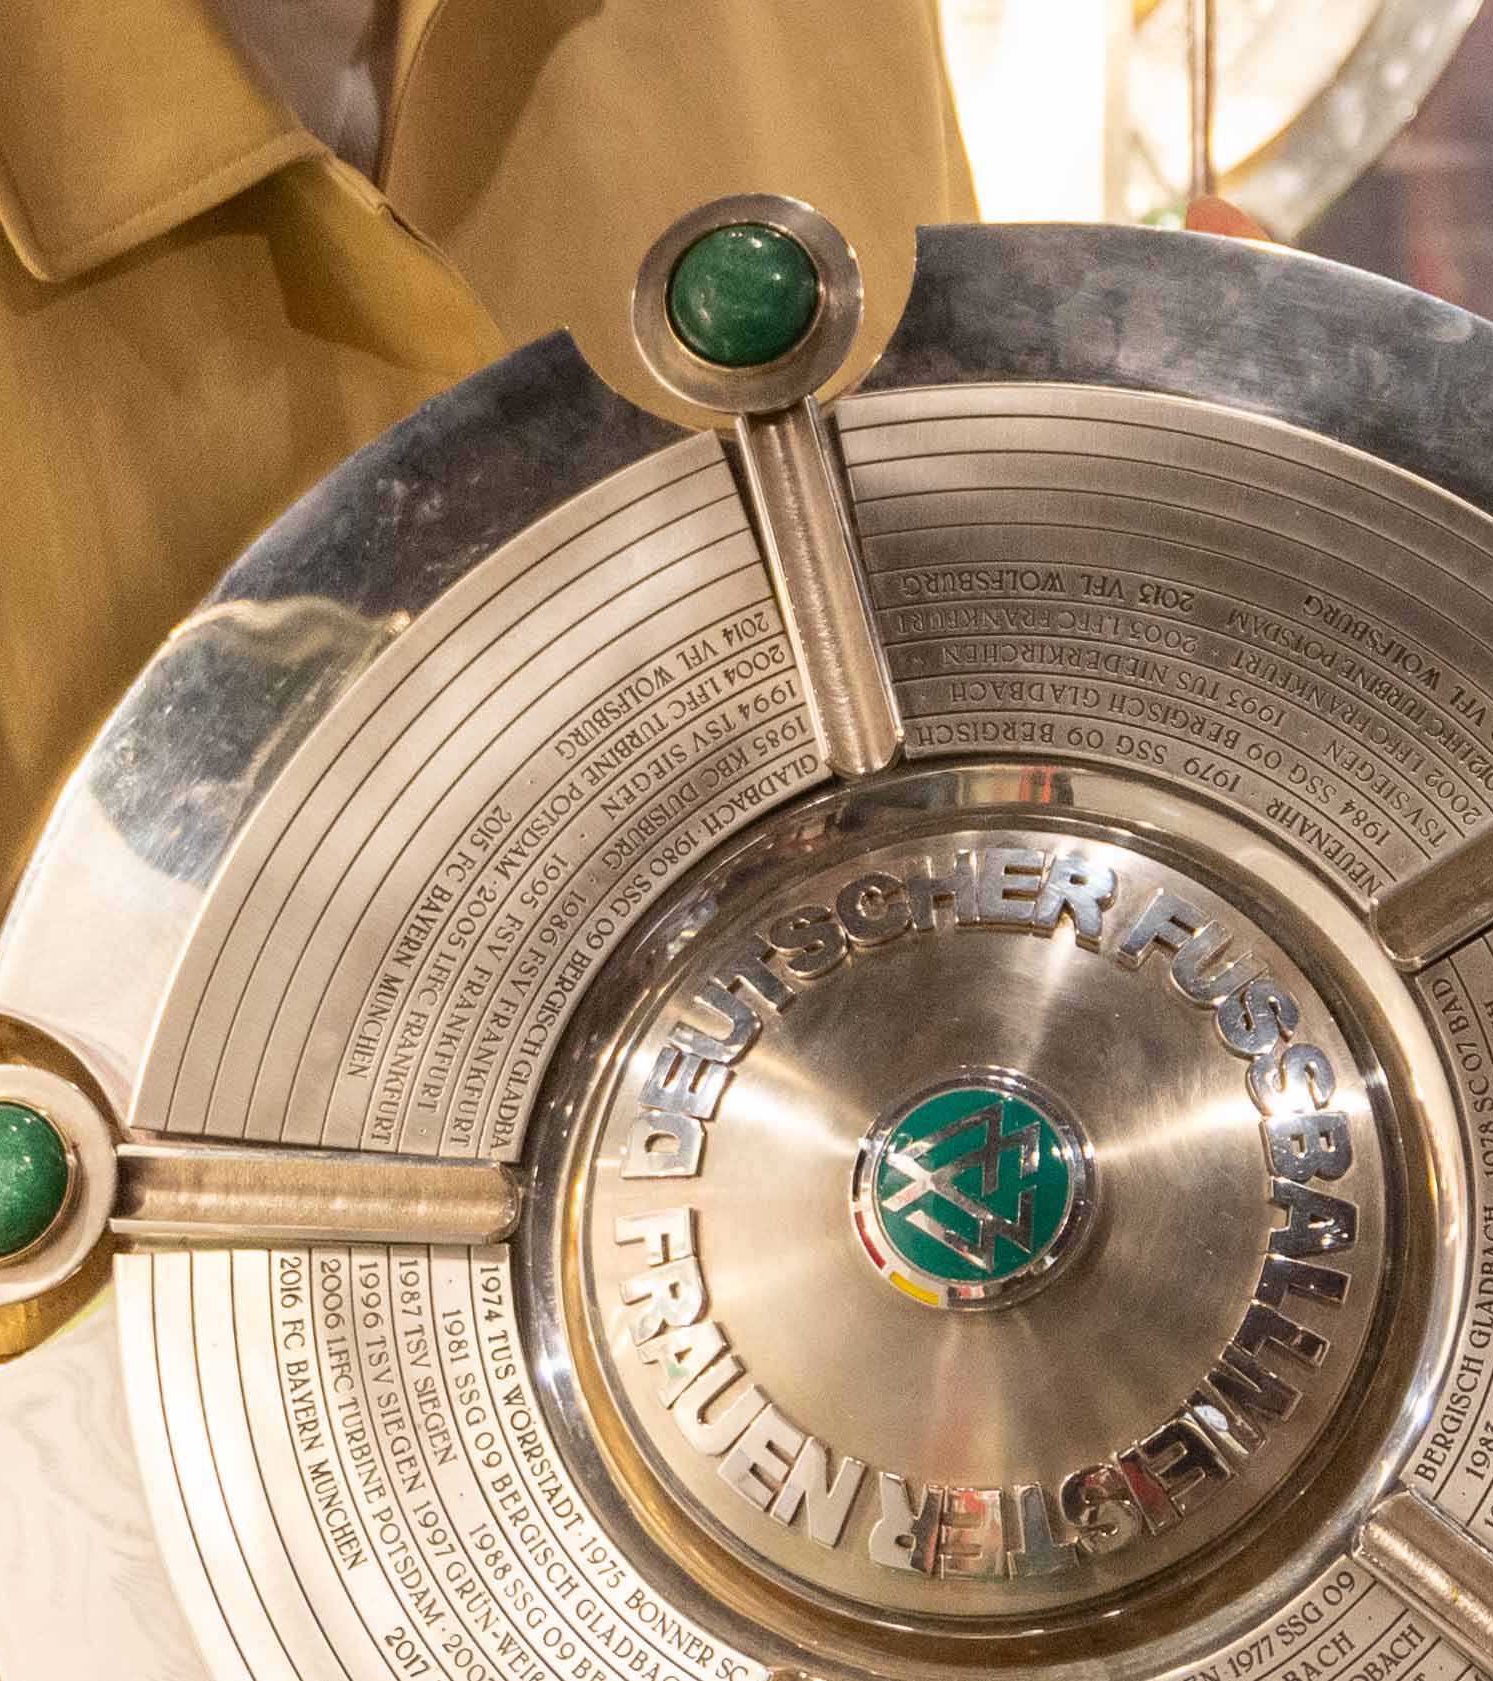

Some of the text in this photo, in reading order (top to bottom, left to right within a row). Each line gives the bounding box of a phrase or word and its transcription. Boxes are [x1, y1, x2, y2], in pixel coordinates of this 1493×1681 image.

[901, 569, 1066, 596] WOLFSBURG
[1079, 573, 1125, 600] VFL
[1138, 582, 1196, 613] 2013
[721, 611, 769, 647] 2014
[895, 602, 1054, 633] FRANKFURT
[1129, 618, 1199, 654] 2003
[1226, 608, 1340, 668] POTSDAM
[1303, 594, 1441, 691] WOLFSBURG
[675, 639, 719, 671] VFL
[722, 643, 785, 686] 2004
[554, 665, 676, 761] WOLFSBURG
[951, 680, 1101, 709] GLADBACH
[1230, 649, 1372, 733] FRANKFURT
[1340, 658, 1428, 725] TURBINE
[1449, 685, 1487, 727] VFL
[580, 712, 669, 787] TURBINE
[914, 721, 1055, 747] BERGISCH
[945, 642, 1447, 848] TSV SIEGEN 1993 TUS NIEDERKIRCHEN
[1107, 692, 1242, 750] BERGISCH
[1115, 734, 1168, 765] SSG
[700, 753, 819, 837] GLADBACH
[1182, 756, 1242, 793] 1979
[1287, 762, 1337, 804] SSG
[1424, 767, 1483, 825] 2002
[470, 804, 512, 853] 2015
[493, 781, 585, 881] POTSDAM
[1265, 797, 1384, 898] NEUENAHR
[1339, 799, 1391, 846] 1984
[445, 851, 477, 883] FC
[649, 830, 699, 877] 1980
[417, 679, 797, 1110] 1994 TSV SIEGEN 1995 FSV FRANKFURT
[447, 884, 497, 950] 2005
[609, 873, 652, 918] SSG
[392, 883, 454, 969] BAYERN
[449, 715, 808, 1144] 1985 KBC DUISBURG 1986 FSV FRANKFURT
[519, 949, 593, 1057] BERGISCH
[1431, 978, 1470, 1035] BAD
[370, 1010, 430, 1145] FRANKFURT
[620, 847, 1360, 1582] DEUTSCHER FUSSBALLMEISTER
[280, 1257, 303, 1309] 2016
[359, 1262, 384, 1329] 1996
[399, 1260, 423, 1317] 1987
[480, 1266, 504, 1323] 1974
[281, 1318, 306, 1350] FC
[365, 1335, 395, 1384] TSV
[403, 1323, 432, 1368] TSV
[441, 1309, 470, 1363] 1981
[487, 1329, 516, 1380] TUS
[286, 1359, 322, 1452] BAYERN
[454, 1372, 487, 1427] SSG
[615, 1207, 865, 1548] FRAUEN
[320, 1259, 346, 1330] 2006
[337, 1396, 387, 1504] TURBINE
[371, 1506, 446, 1627] POTSDAM
[377, 1391, 426, 1494] SIEGEN
[413, 1375, 458, 1466] SIEGEN
[1413, 1354, 1485, 1483] BERGISCH
[412, 1500, 456, 1557] 1997
[468, 1522, 512, 1581] 1988
[490, 1472, 580, 1600] BERGISCH
[579, 1536, 626, 1589] 1975
[503, 1578, 548, 1630] SSG
[624, 1587, 715, 1668] BONNER
[384, 1626, 431, 1678] 2017
[1227, 1635, 1275, 1678] 1977
[1275, 1602, 1324, 1646] SSG
